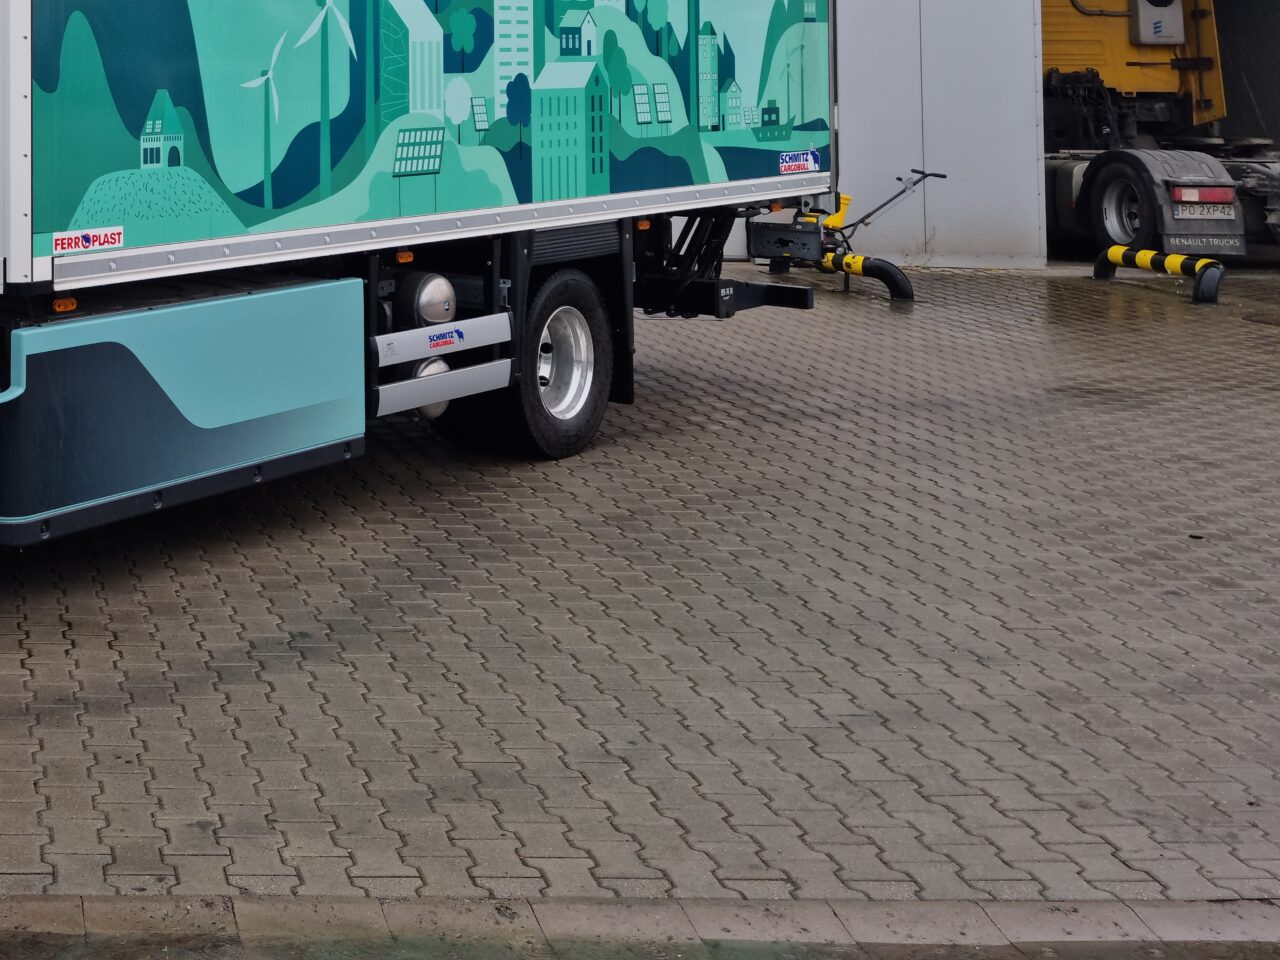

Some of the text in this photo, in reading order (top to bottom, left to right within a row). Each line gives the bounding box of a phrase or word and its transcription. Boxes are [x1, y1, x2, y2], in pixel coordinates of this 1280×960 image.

[781, 152, 809, 164] SCHMITZ
[781, 163, 809, 172] CARGOBULL
[54, 231, 122, 251] FERROPLAST
[1169, 237, 1240, 247] RENAULT TRUCKS
[428, 331, 455, 343] SCHMITZ
